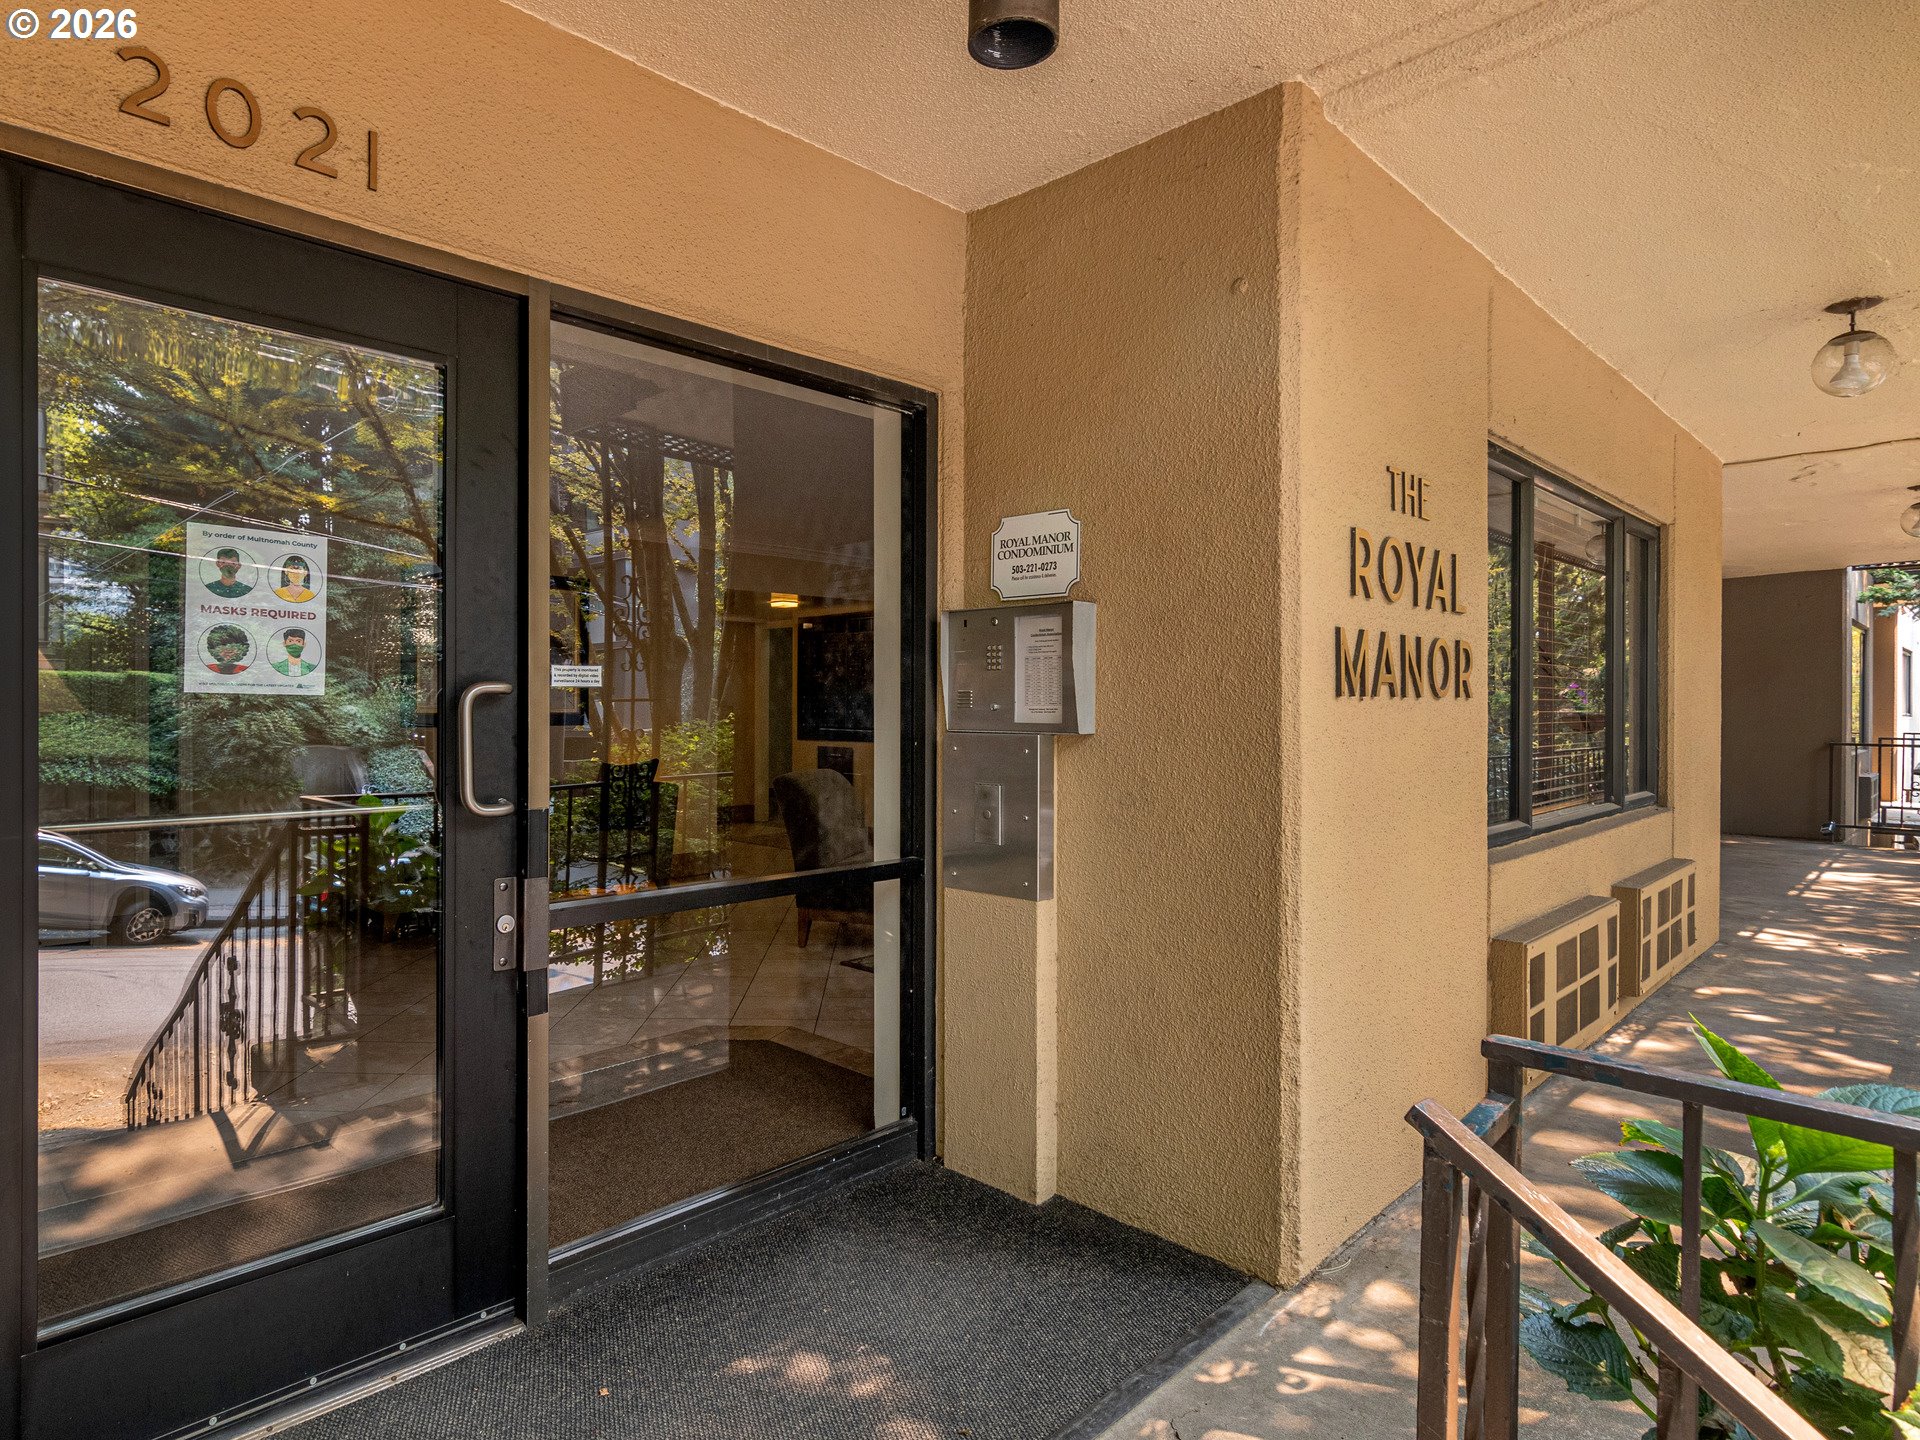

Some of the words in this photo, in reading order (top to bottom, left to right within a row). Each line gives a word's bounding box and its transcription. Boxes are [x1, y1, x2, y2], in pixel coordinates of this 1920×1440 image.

[116, 45, 379, 192] 2021
[1386, 465, 1431, 522] THE
[202, 530, 213, 539] By
[214, 532, 236, 541] order
[247, 535, 291, 546] Multnomah
[292, 540, 318, 550] County
[1000, 536, 1031, 550] ROYAL
[1032, 531, 1071, 545] MANOR
[997, 542, 1075, 561] CONDOMINIUM
[1011, 561, 1058, 575] 503-221-0273
[1350, 526, 1467, 615] ROYAL
[200, 604, 247, 616] MASKS
[251, 607, 317, 621] REQUIRED
[1335, 626, 1474, 700] MANOR
